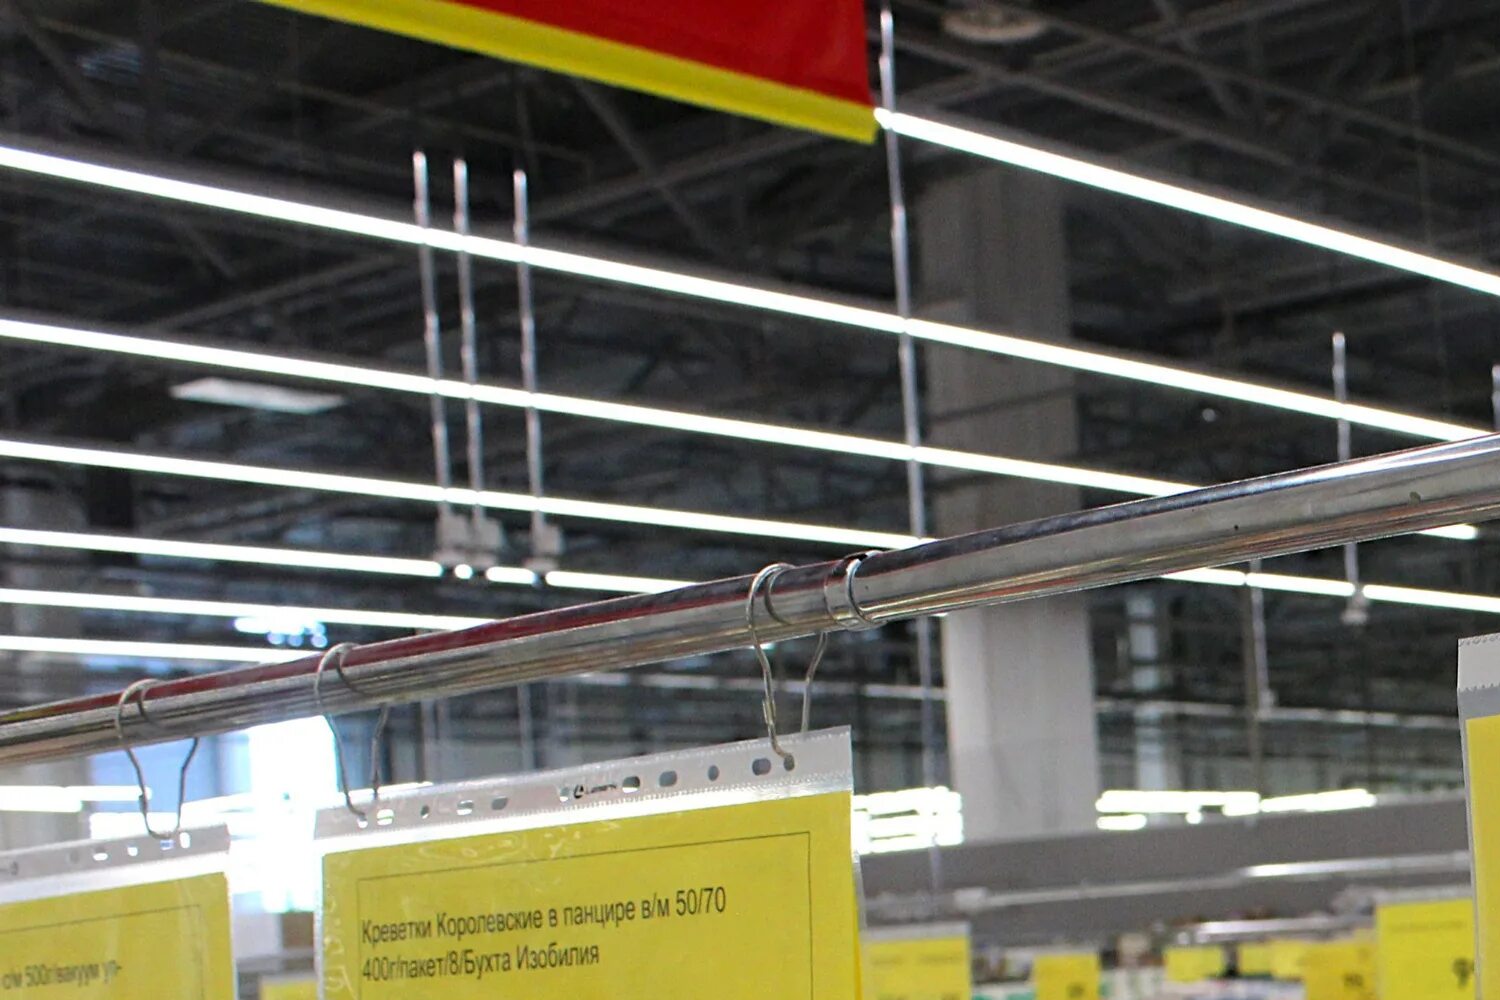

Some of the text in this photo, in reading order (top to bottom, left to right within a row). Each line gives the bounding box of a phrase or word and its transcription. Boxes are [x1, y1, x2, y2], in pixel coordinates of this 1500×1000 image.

[361, 886, 727, 945] Креветки Королевские в панцире в/м 50/70
[362, 942, 600, 982] 400г/пакет/8/Бухта Изобилия
